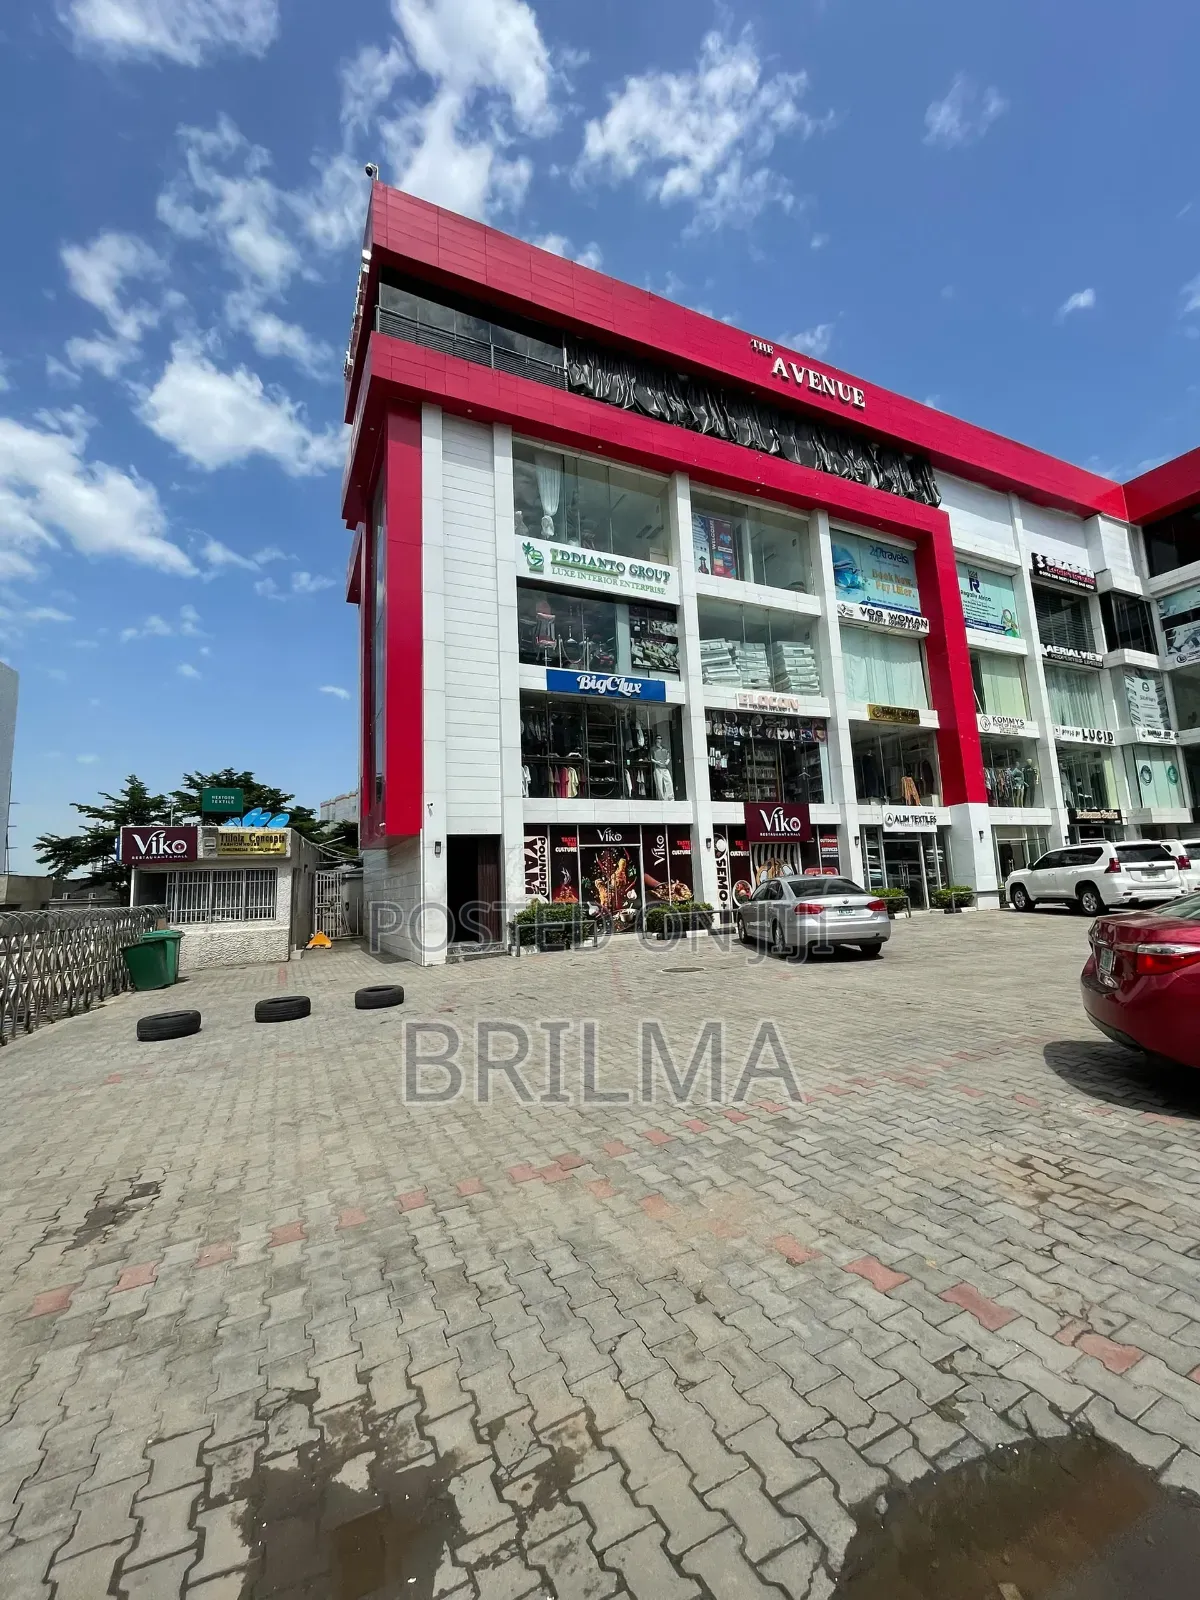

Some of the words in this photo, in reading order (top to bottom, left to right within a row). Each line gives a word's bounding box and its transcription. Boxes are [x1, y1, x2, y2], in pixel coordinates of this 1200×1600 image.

[751, 339, 774, 355] THE
[771, 357, 866, 408] AVENUE
[552, 567, 576, 578] LUXE
[577, 572, 619, 587] INTERIOR
[620, 580, 666, 595] ENTERPRISE
[629, 563, 671, 584] GROUP
[860, 606, 884, 617] VOG
[888, 612, 928, 628] WOMAN
[992, 716, 1025, 726] KOMMYS
[1082, 729, 1114, 742] LUCID
[759, 807, 801, 832] Viko
[911, 815, 937, 824] TEXTILES
[132, 830, 187, 855] Viko
[249, 833, 285, 844] Concepts
[597, 827, 623, 842] Viko
[651, 835, 666, 867] Viko
[524, 837, 539, 895] YAM
[538, 837, 547, 896] POUNDED
